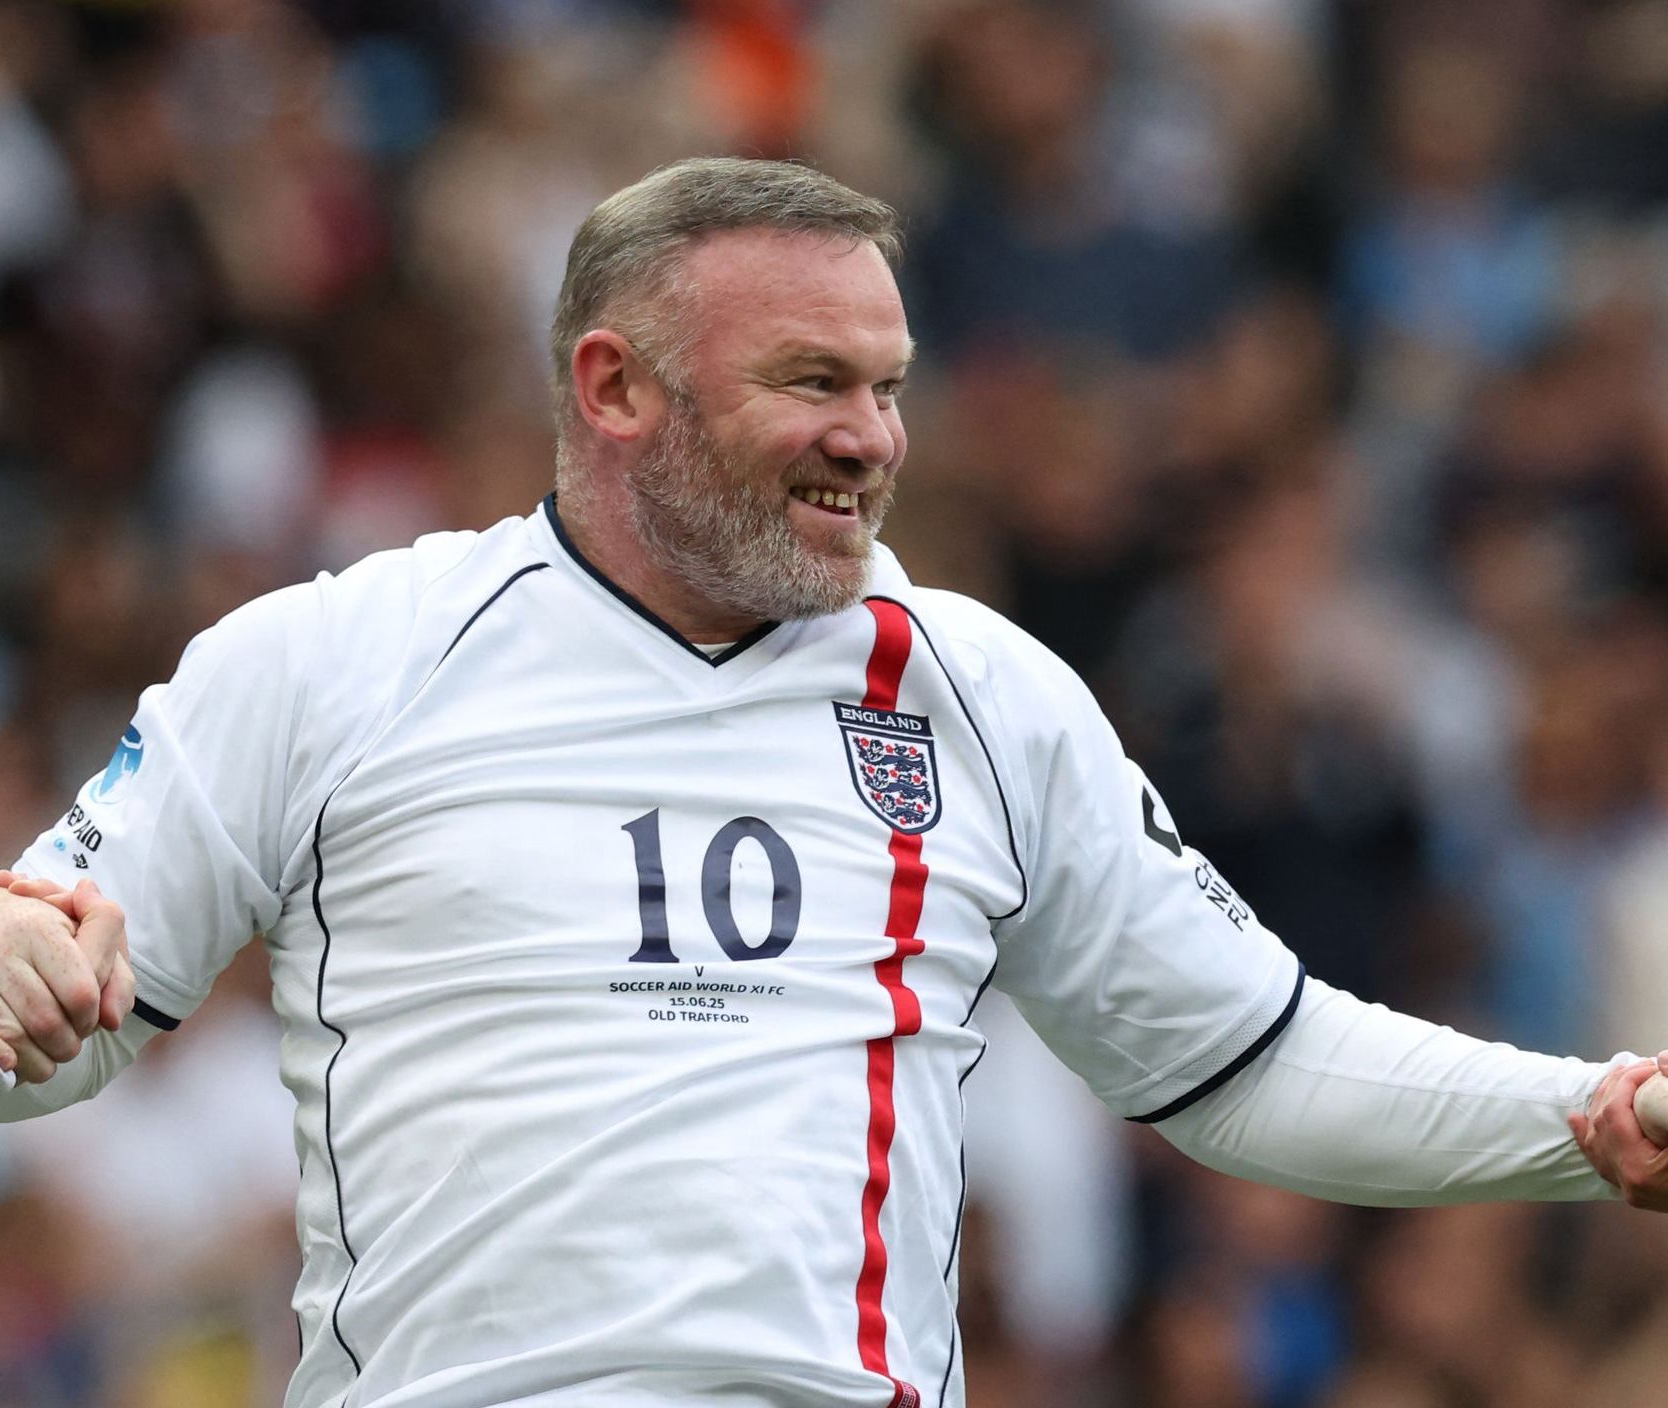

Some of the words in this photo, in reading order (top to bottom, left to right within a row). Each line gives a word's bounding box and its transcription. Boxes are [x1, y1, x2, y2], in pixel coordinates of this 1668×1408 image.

[840, 707, 922, 731] ENGLAND
[621, 807, 802, 963] 10
[609, 981, 665, 993] SOCCER
[668, 981, 692, 991] AID
[696, 982, 747, 993] WORLD
[749, 984, 765, 995] XI
[768, 986, 785, 996] FC
[669, 996, 725, 1009] 15.06.25
[648, 1009, 676, 1022] OLD
[680, 1010, 749, 1024] TRAFFORD
